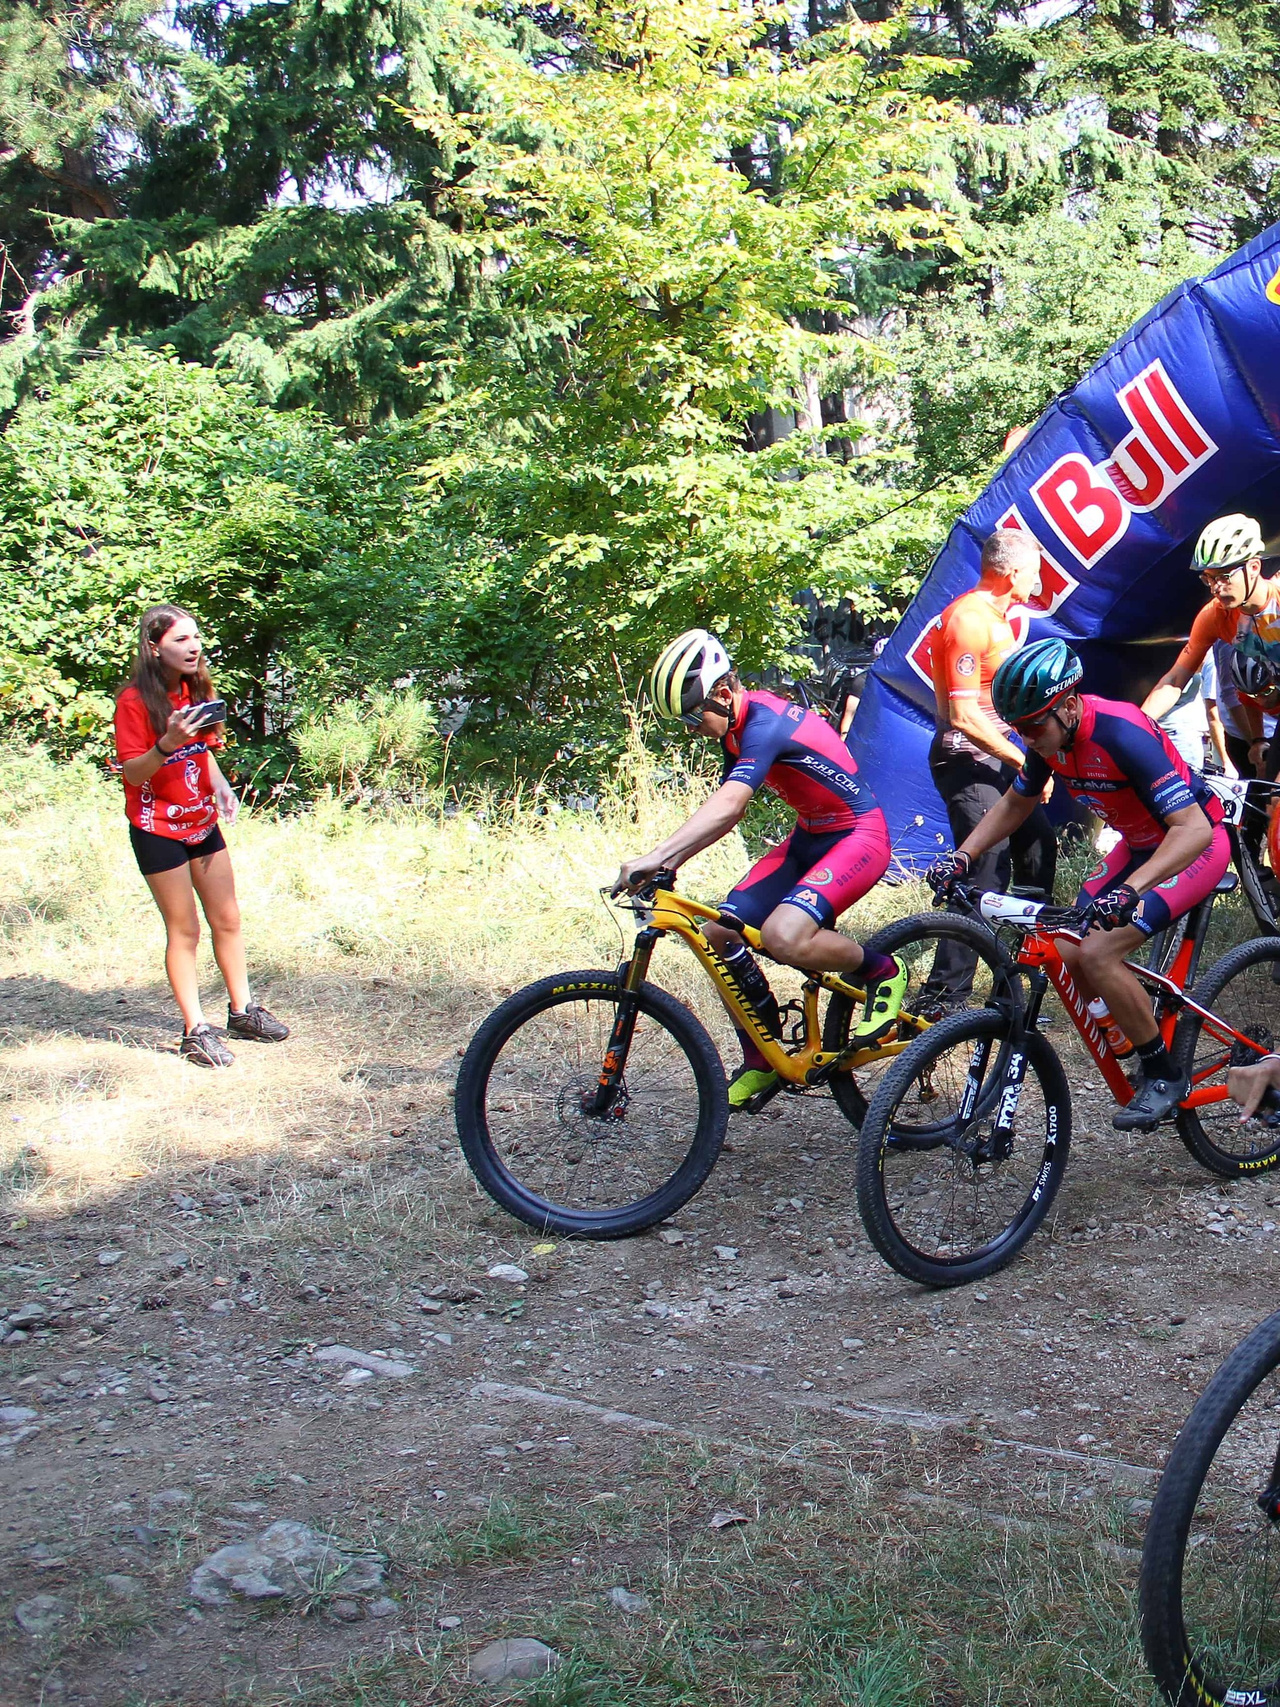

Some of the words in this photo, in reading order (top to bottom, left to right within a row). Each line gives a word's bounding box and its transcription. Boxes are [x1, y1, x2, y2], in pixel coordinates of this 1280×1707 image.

[1029, 358, 1219, 570] Bull
[551, 980, 618, 996] MAXXIS
[1006, 1052, 1024, 1081] 34
[1046, 1105, 1057, 1146] X1700
[1239, 1154, 1278, 1170] MAXXIS
[1031, 1186, 1042, 1202] DT
[1038, 1160, 1052, 1188] SWISS
